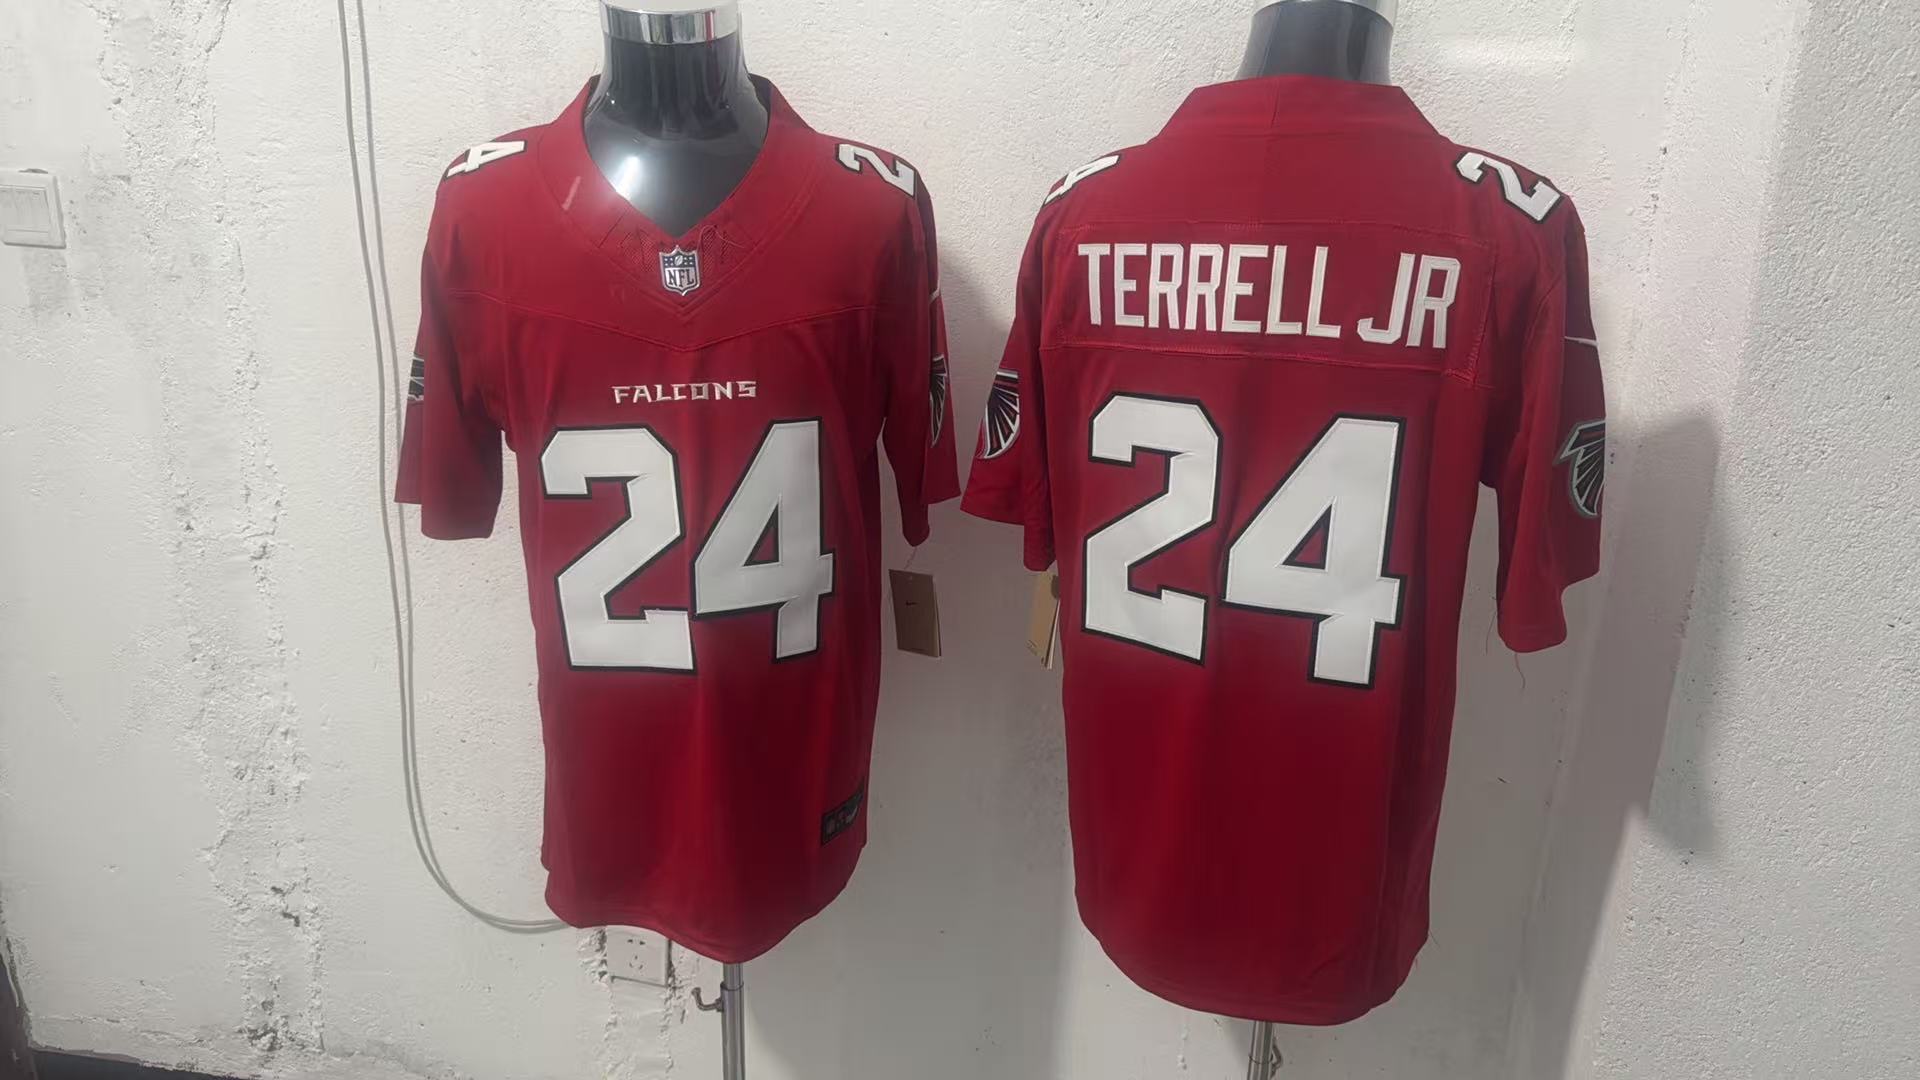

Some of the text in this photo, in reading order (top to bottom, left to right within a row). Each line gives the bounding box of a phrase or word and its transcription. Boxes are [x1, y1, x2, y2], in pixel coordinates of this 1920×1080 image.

[445, 139, 527, 179] 4
[835, 142, 916, 196] 2
[1456, 150, 1562, 223] 2
[668, 269, 696, 287] NFL
[1077, 242, 1462, 349] TERRELL JR
[611, 380, 758, 404] FALCONS
[540, 418, 835, 672] 24
[1081, 392, 1407, 689] 24
